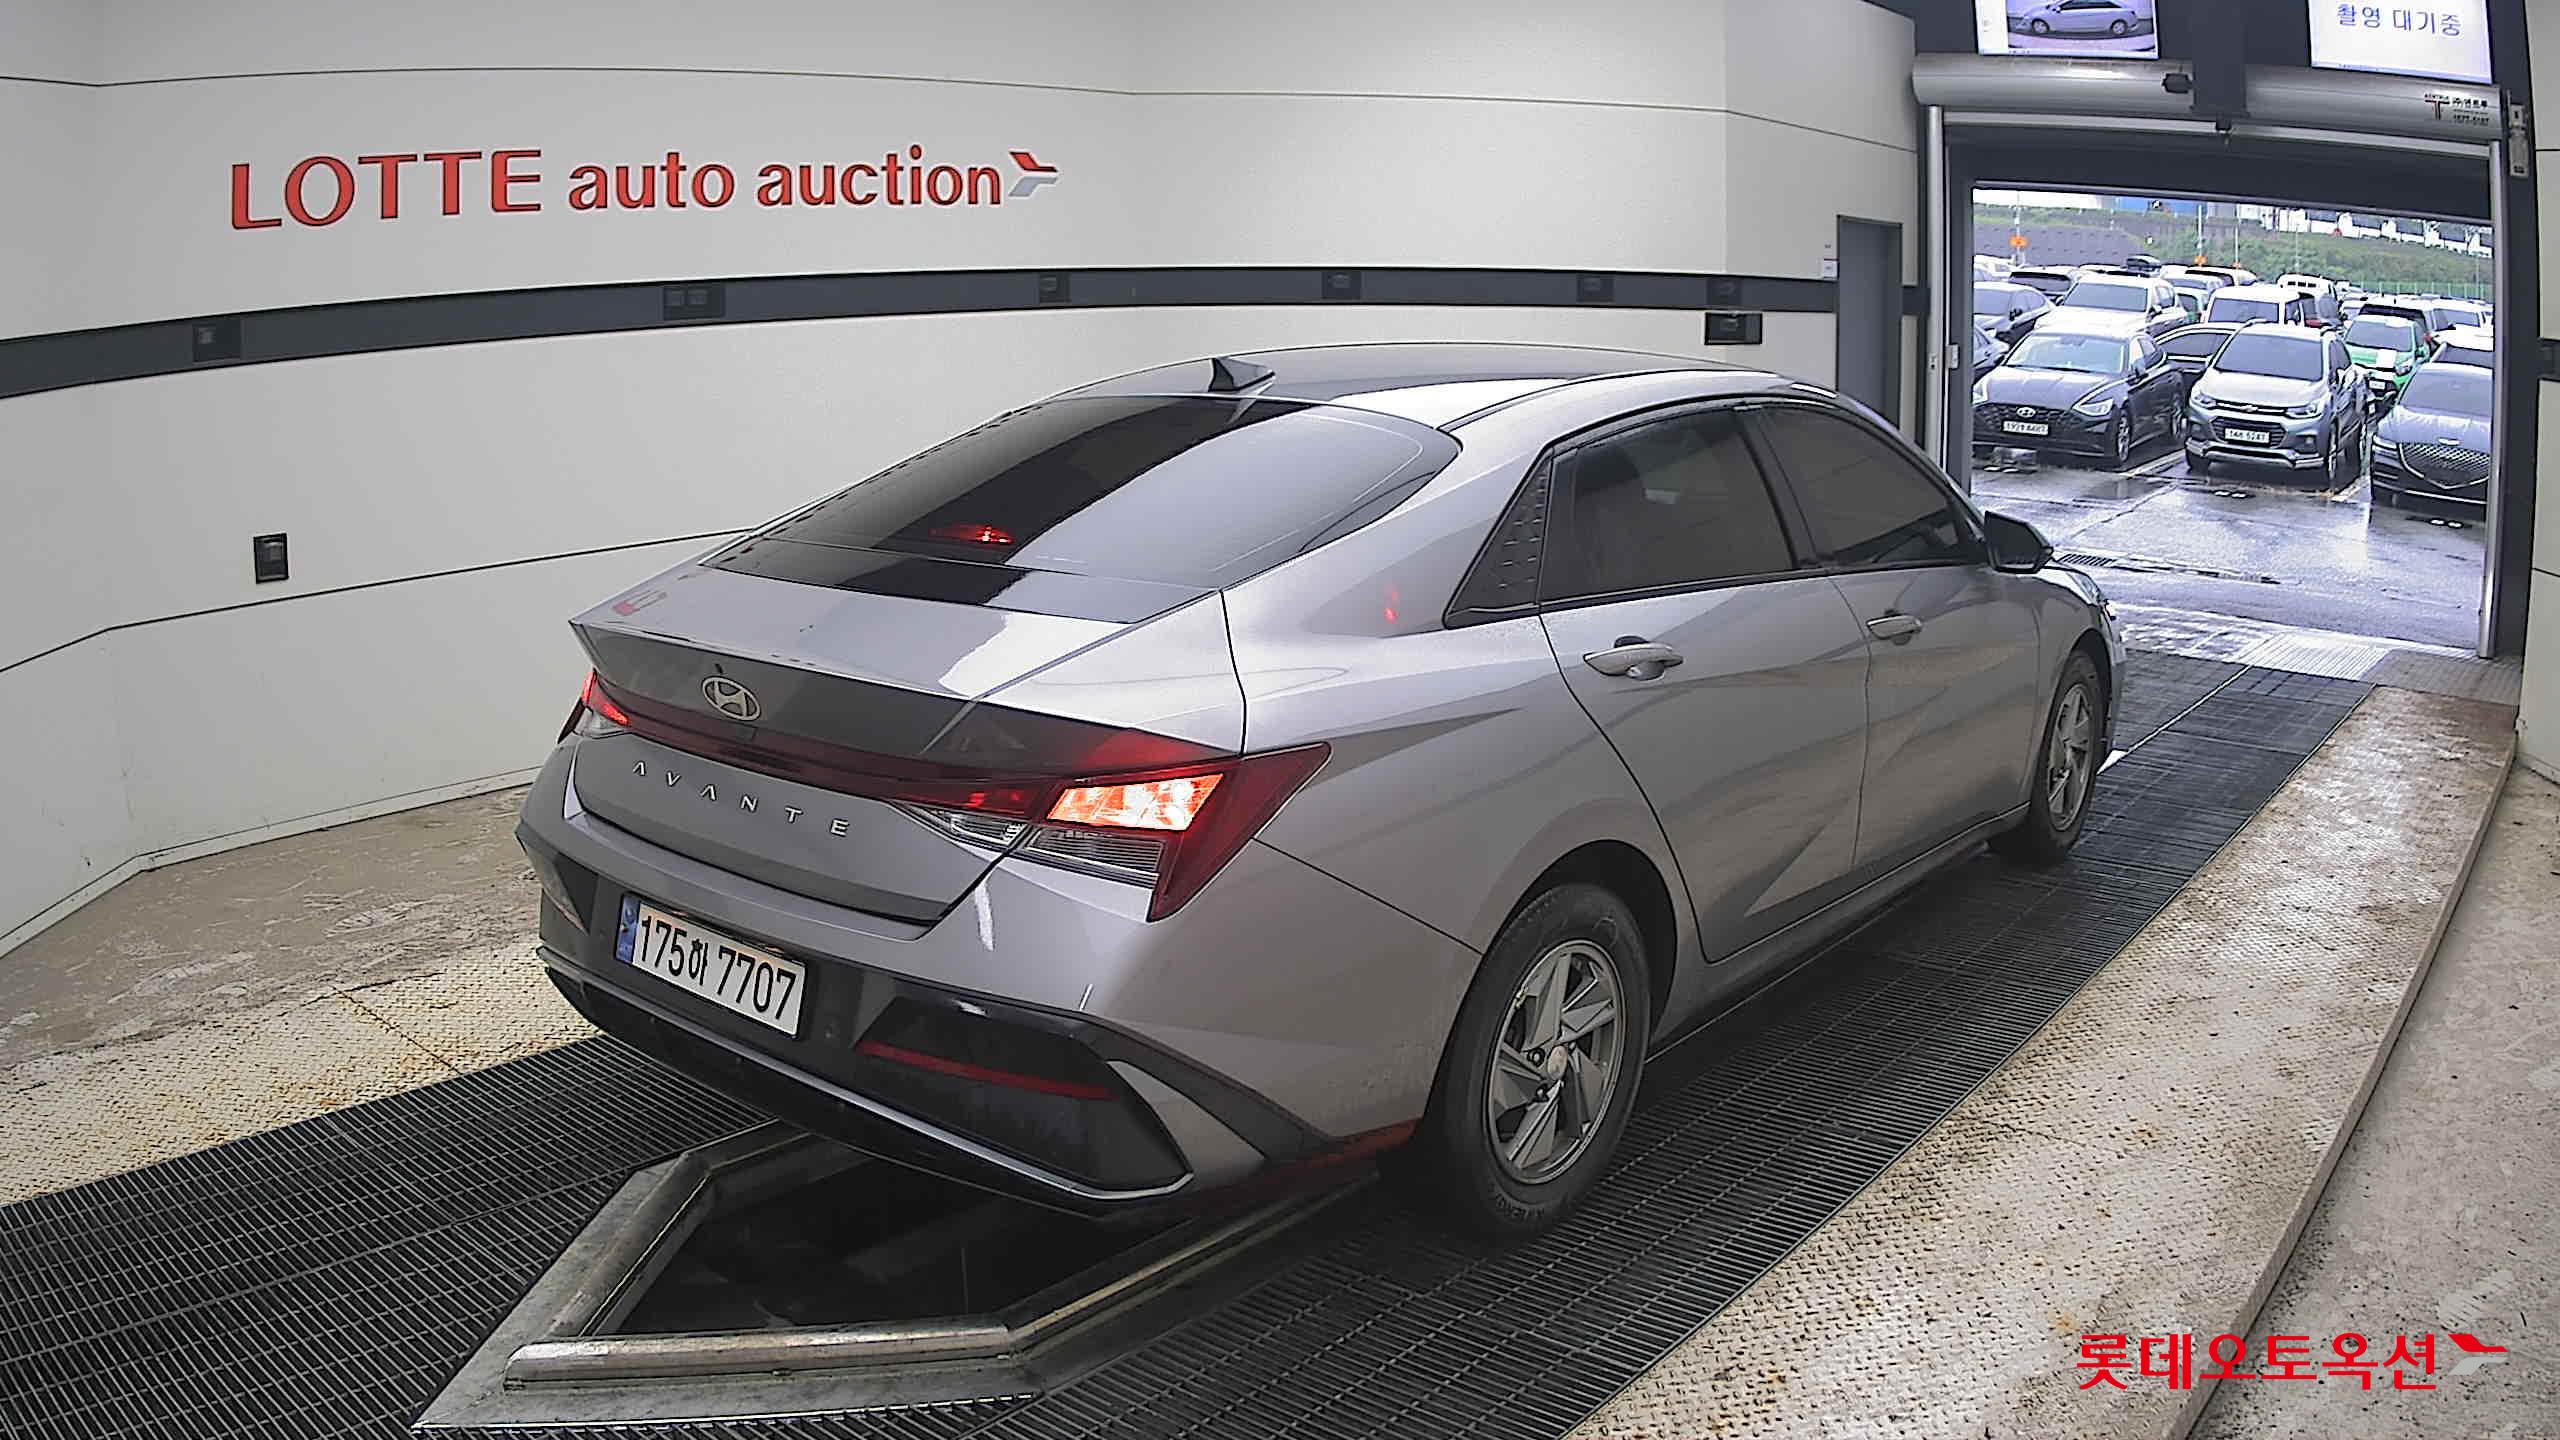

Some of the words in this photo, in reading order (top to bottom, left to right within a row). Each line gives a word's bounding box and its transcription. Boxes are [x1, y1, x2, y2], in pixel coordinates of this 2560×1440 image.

[2337, 4, 2382, 28] 촬영
[2392, 9, 2461, 37] 대기중
[232, 149, 542, 230] LOTTE
[568, 151, 736, 210] auto
[757, 144, 1002, 207] auction
[631, 760, 851, 838] AVANTE
[640, 914, 710, 987] 175하
[717, 945, 798, 1021] 7707
